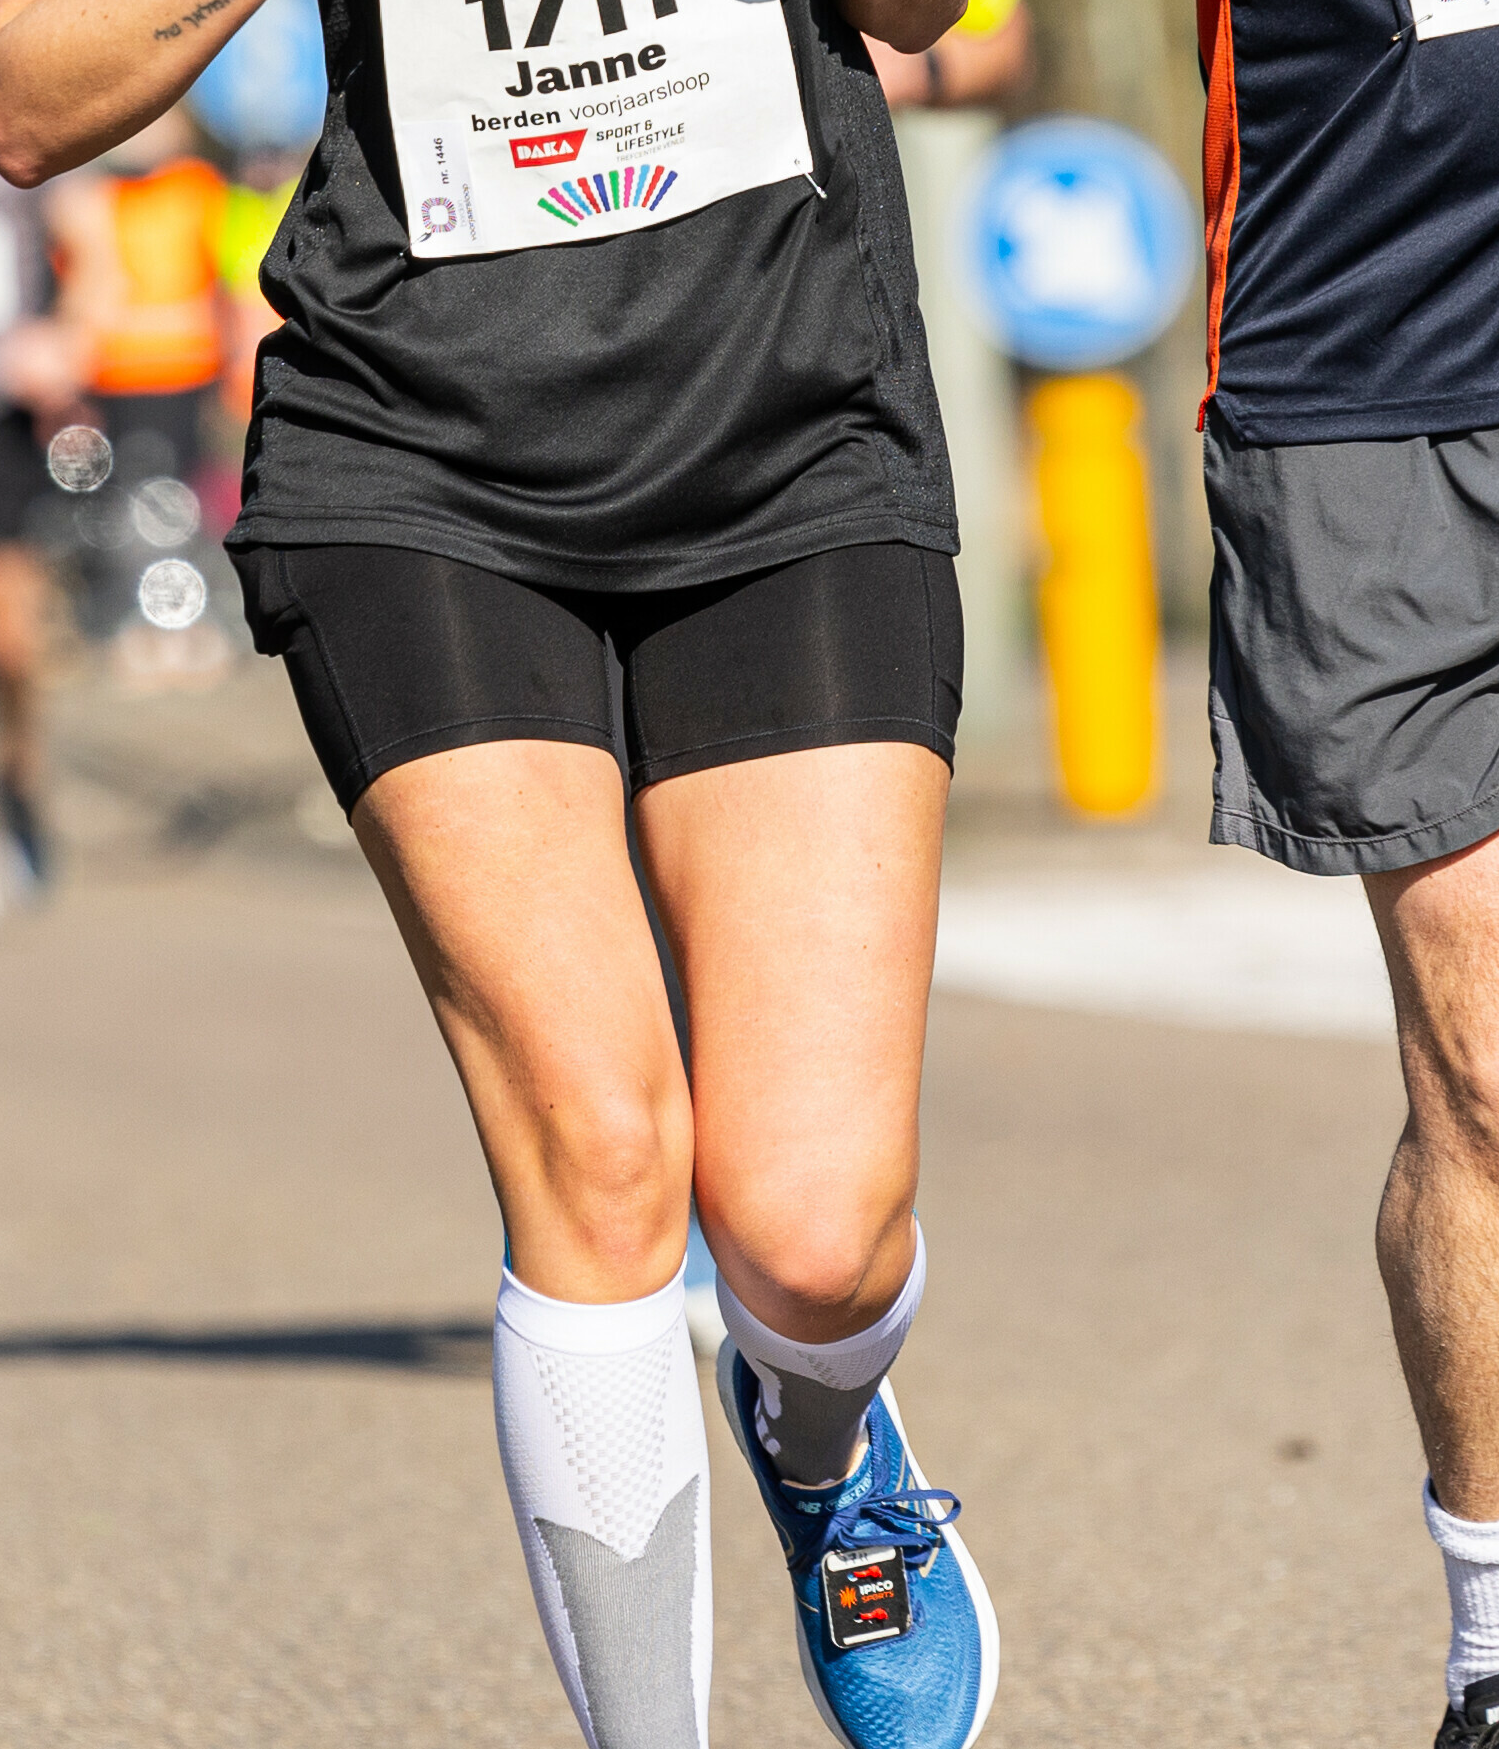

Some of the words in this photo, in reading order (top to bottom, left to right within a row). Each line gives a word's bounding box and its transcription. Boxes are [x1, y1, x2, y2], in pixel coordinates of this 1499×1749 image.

[505, 43, 668, 98] Janne
[471, 109, 562, 133] berden
[569, 69, 711, 122] voorjaarsloop
[596, 122, 641, 142] SPORT
[616, 122, 685, 153] LIFESTYLE
[433, 137, 446, 165] 1446
[515, 140, 577, 159] DAKA
[440, 169, 450, 185] nr.
[858, 1579, 894, 1595] IPICO
[861, 1591, 895, 1603] SPORTS
